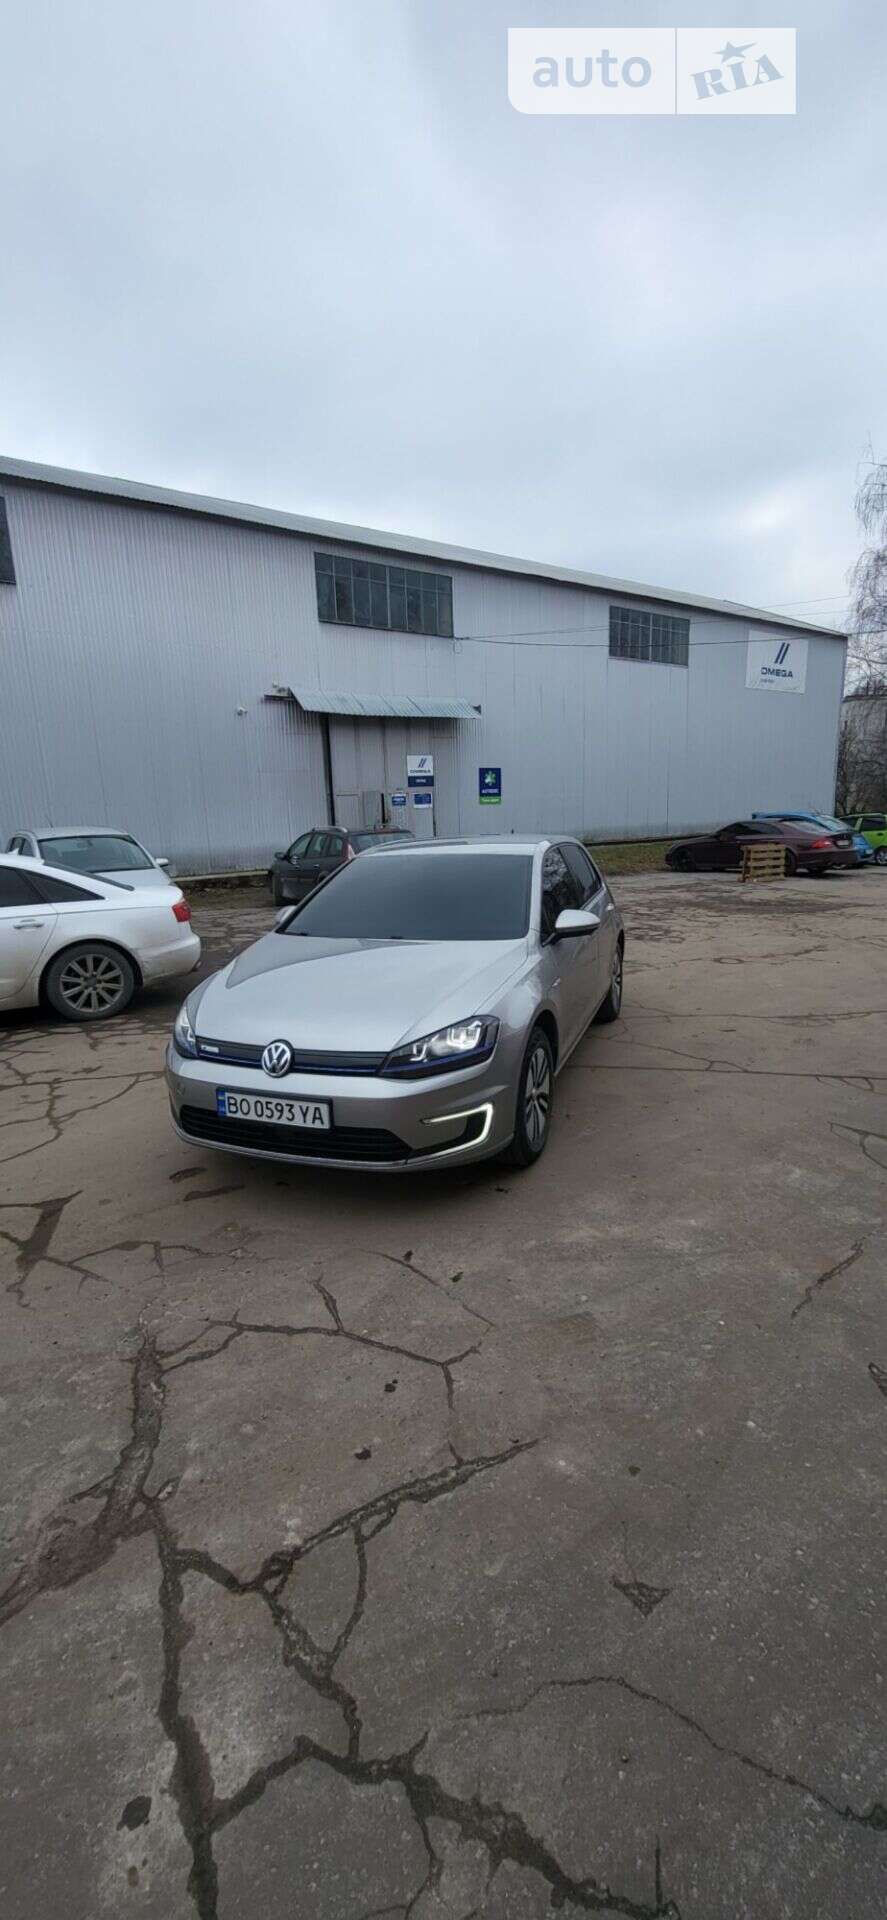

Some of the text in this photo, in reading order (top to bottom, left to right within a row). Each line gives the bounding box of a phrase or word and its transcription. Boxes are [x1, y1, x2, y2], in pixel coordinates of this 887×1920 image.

[761, 667, 793, 678] OMEGA
[227, 1096, 324, 1125] BO 0593 YA
